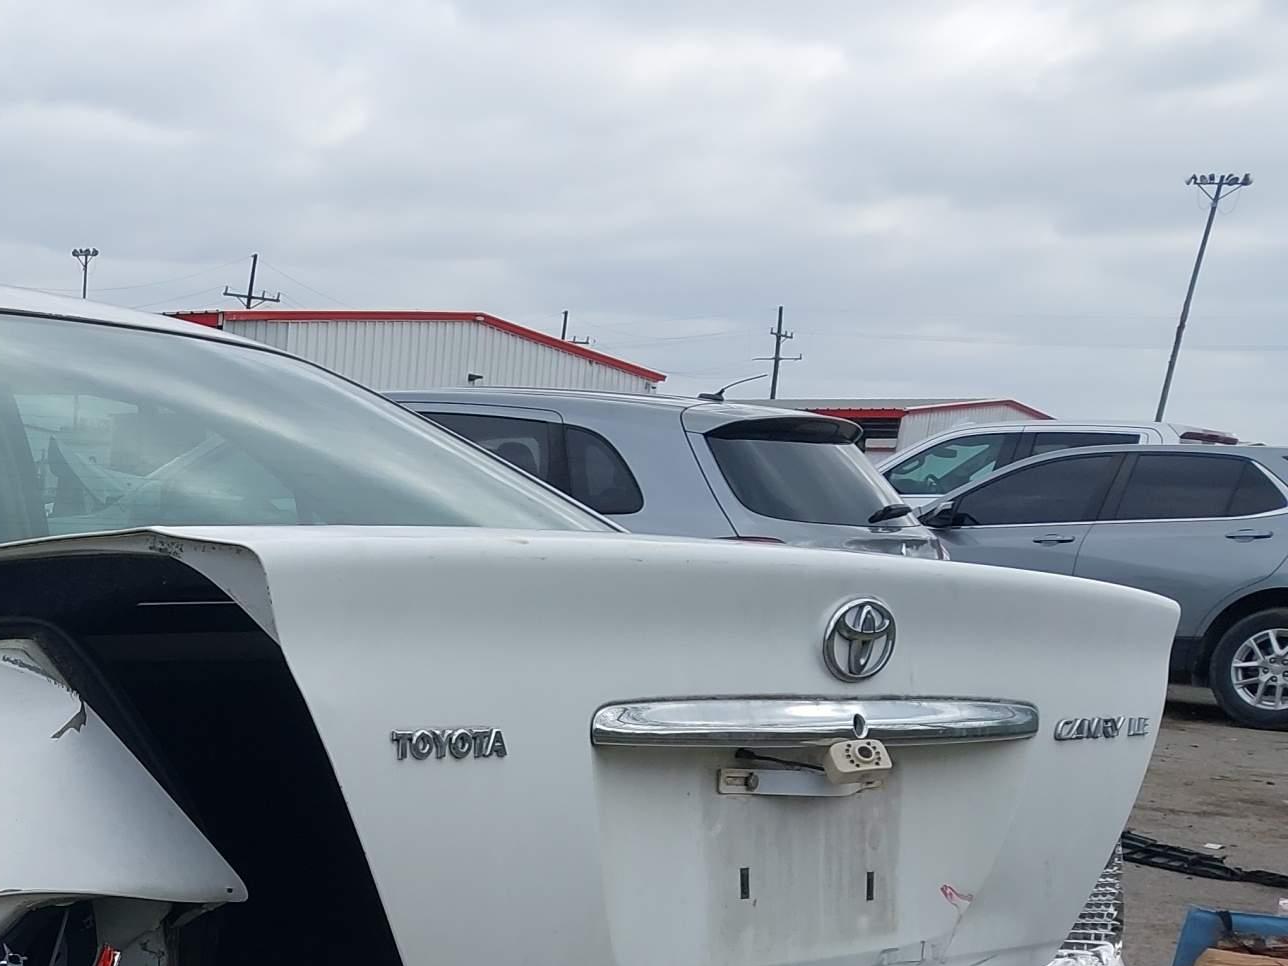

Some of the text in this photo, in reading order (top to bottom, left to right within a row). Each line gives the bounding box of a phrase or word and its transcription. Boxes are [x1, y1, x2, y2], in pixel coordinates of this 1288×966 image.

[1053, 717, 1150, 741] CAMRY LE
[390, 728, 508, 760] TOYOTA
